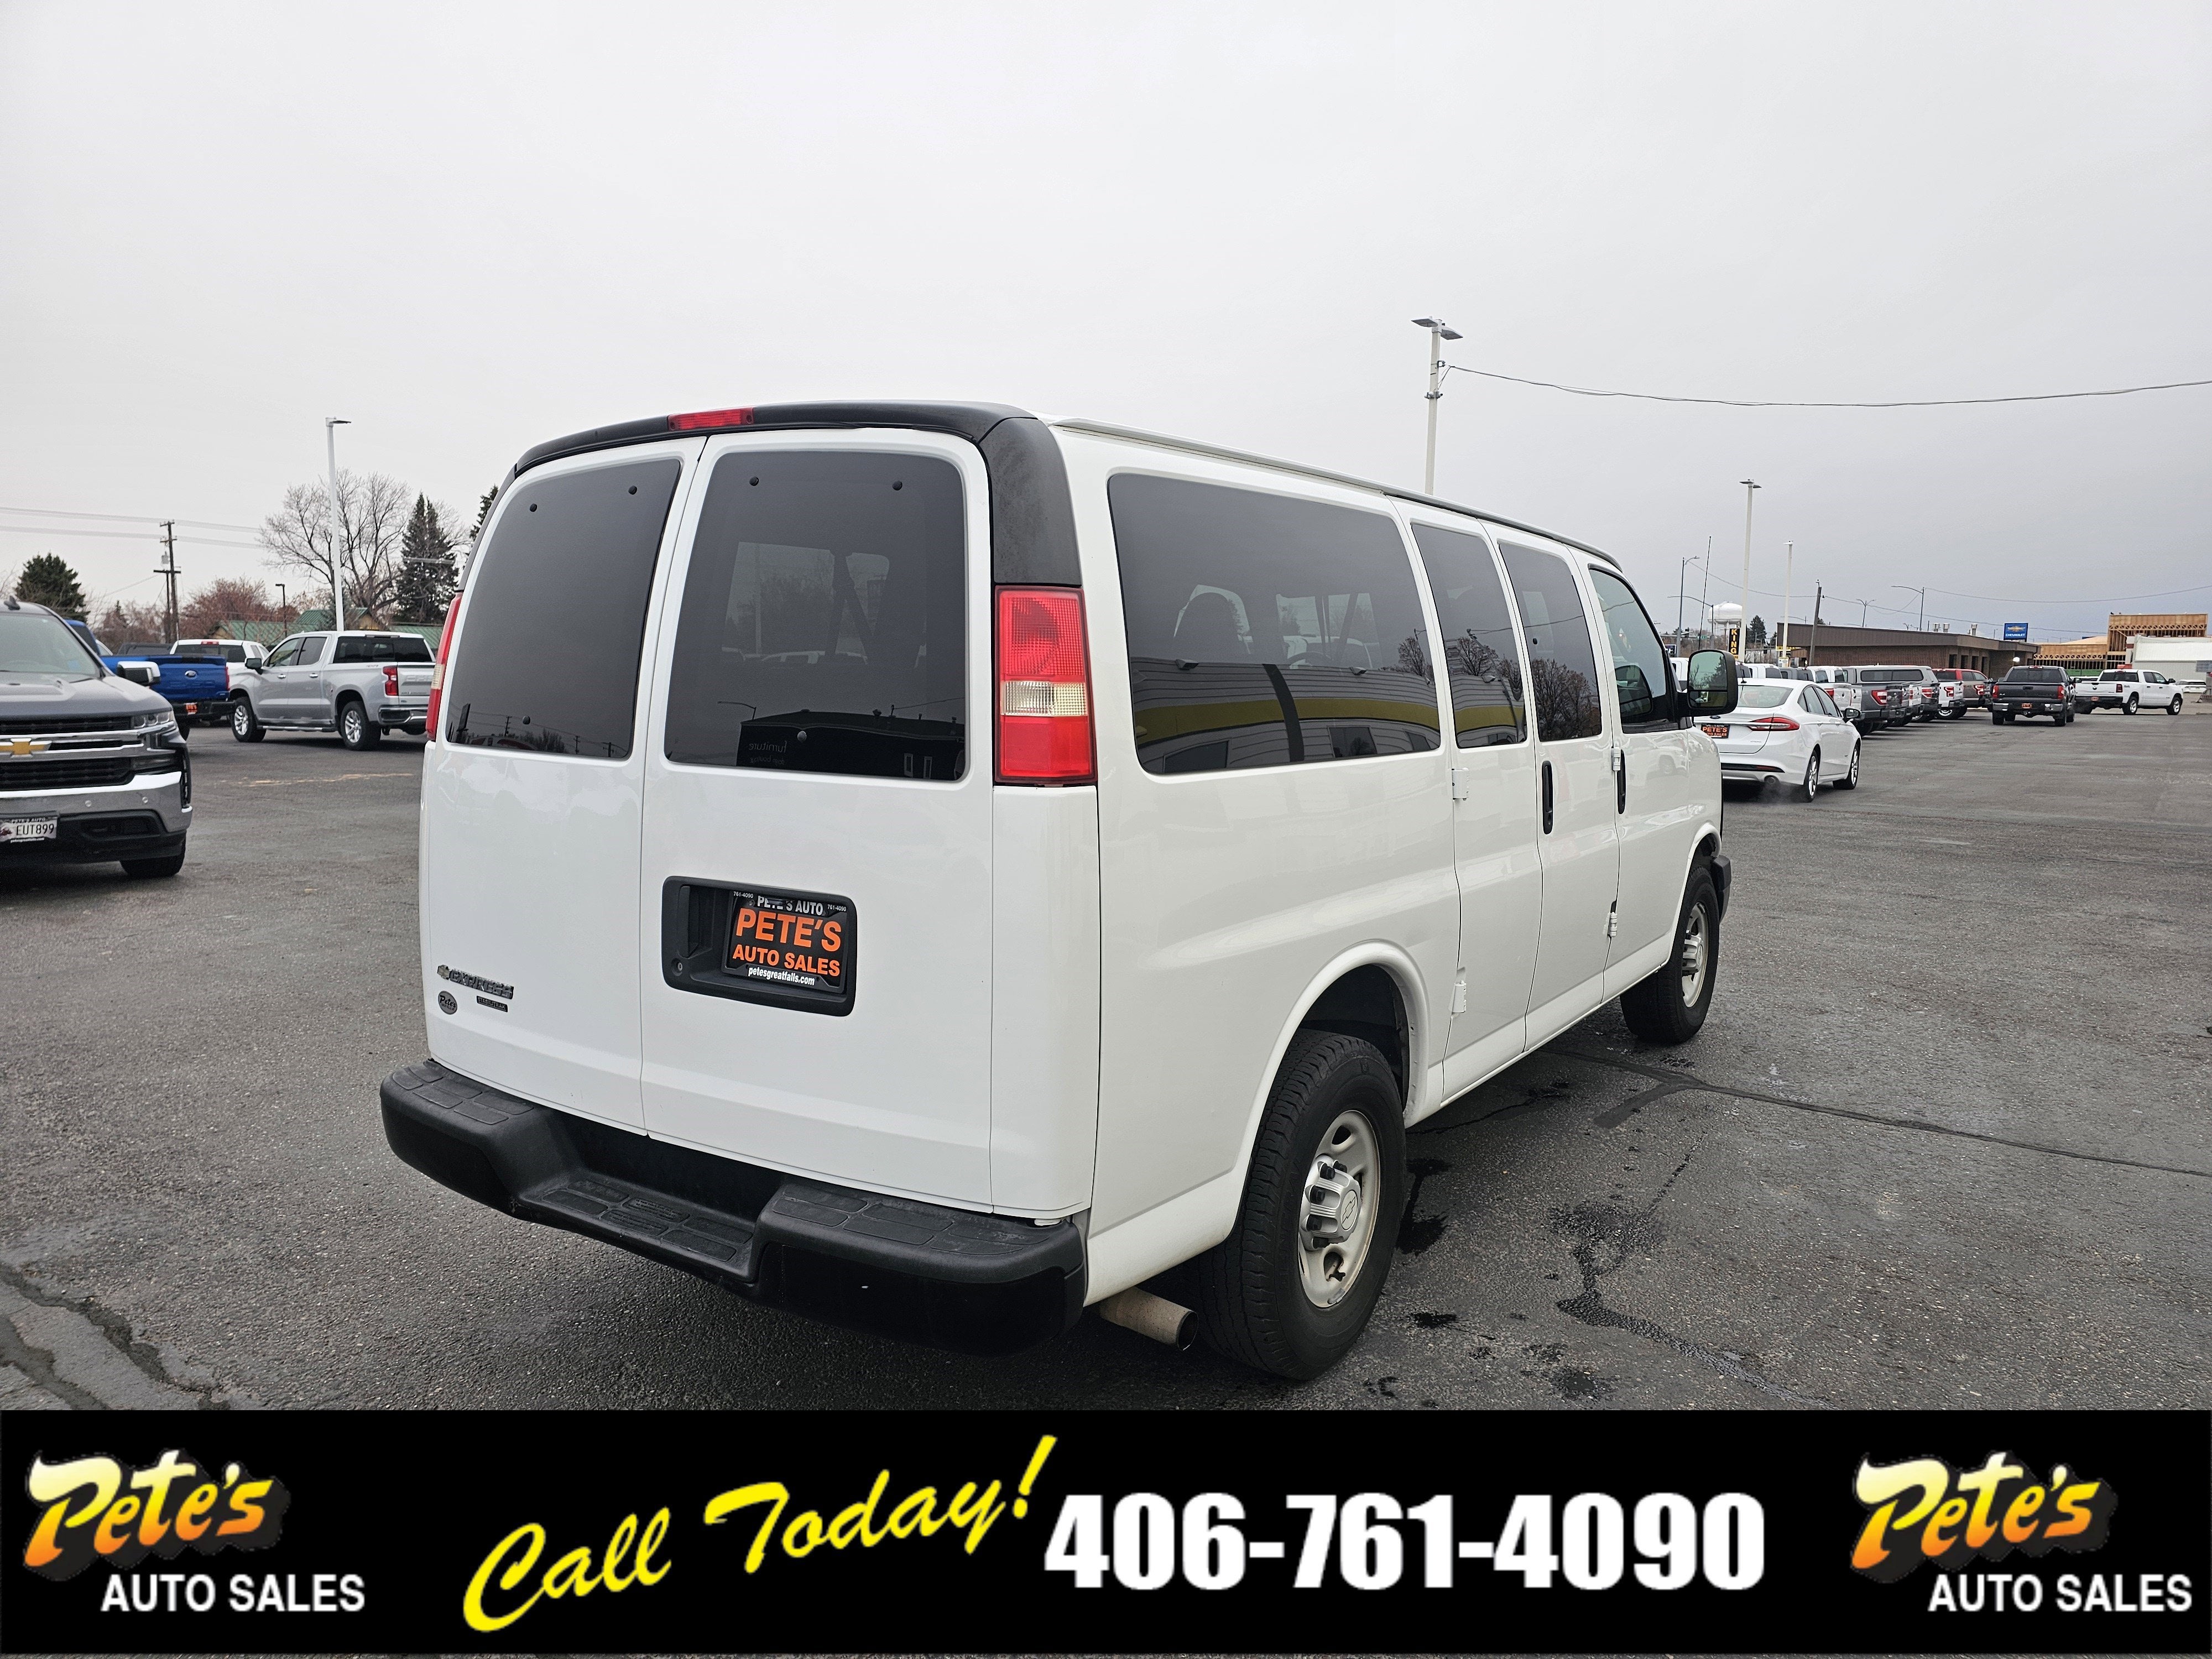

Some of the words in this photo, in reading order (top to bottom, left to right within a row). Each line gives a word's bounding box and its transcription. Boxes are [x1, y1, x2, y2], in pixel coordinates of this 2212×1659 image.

[16, 823, 54, 836] EUT899
[795, 900, 823, 916] AUTO
[827, 904, 847, 912] 761-4090
[735, 907, 841, 952] PETE'S
[732, 944, 779, 966] AUTO
[784, 952, 840, 977] SALES
[449, 968, 514, 1000] EXPRESS
[748, 966, 815, 986] petesgreatfalls.com
